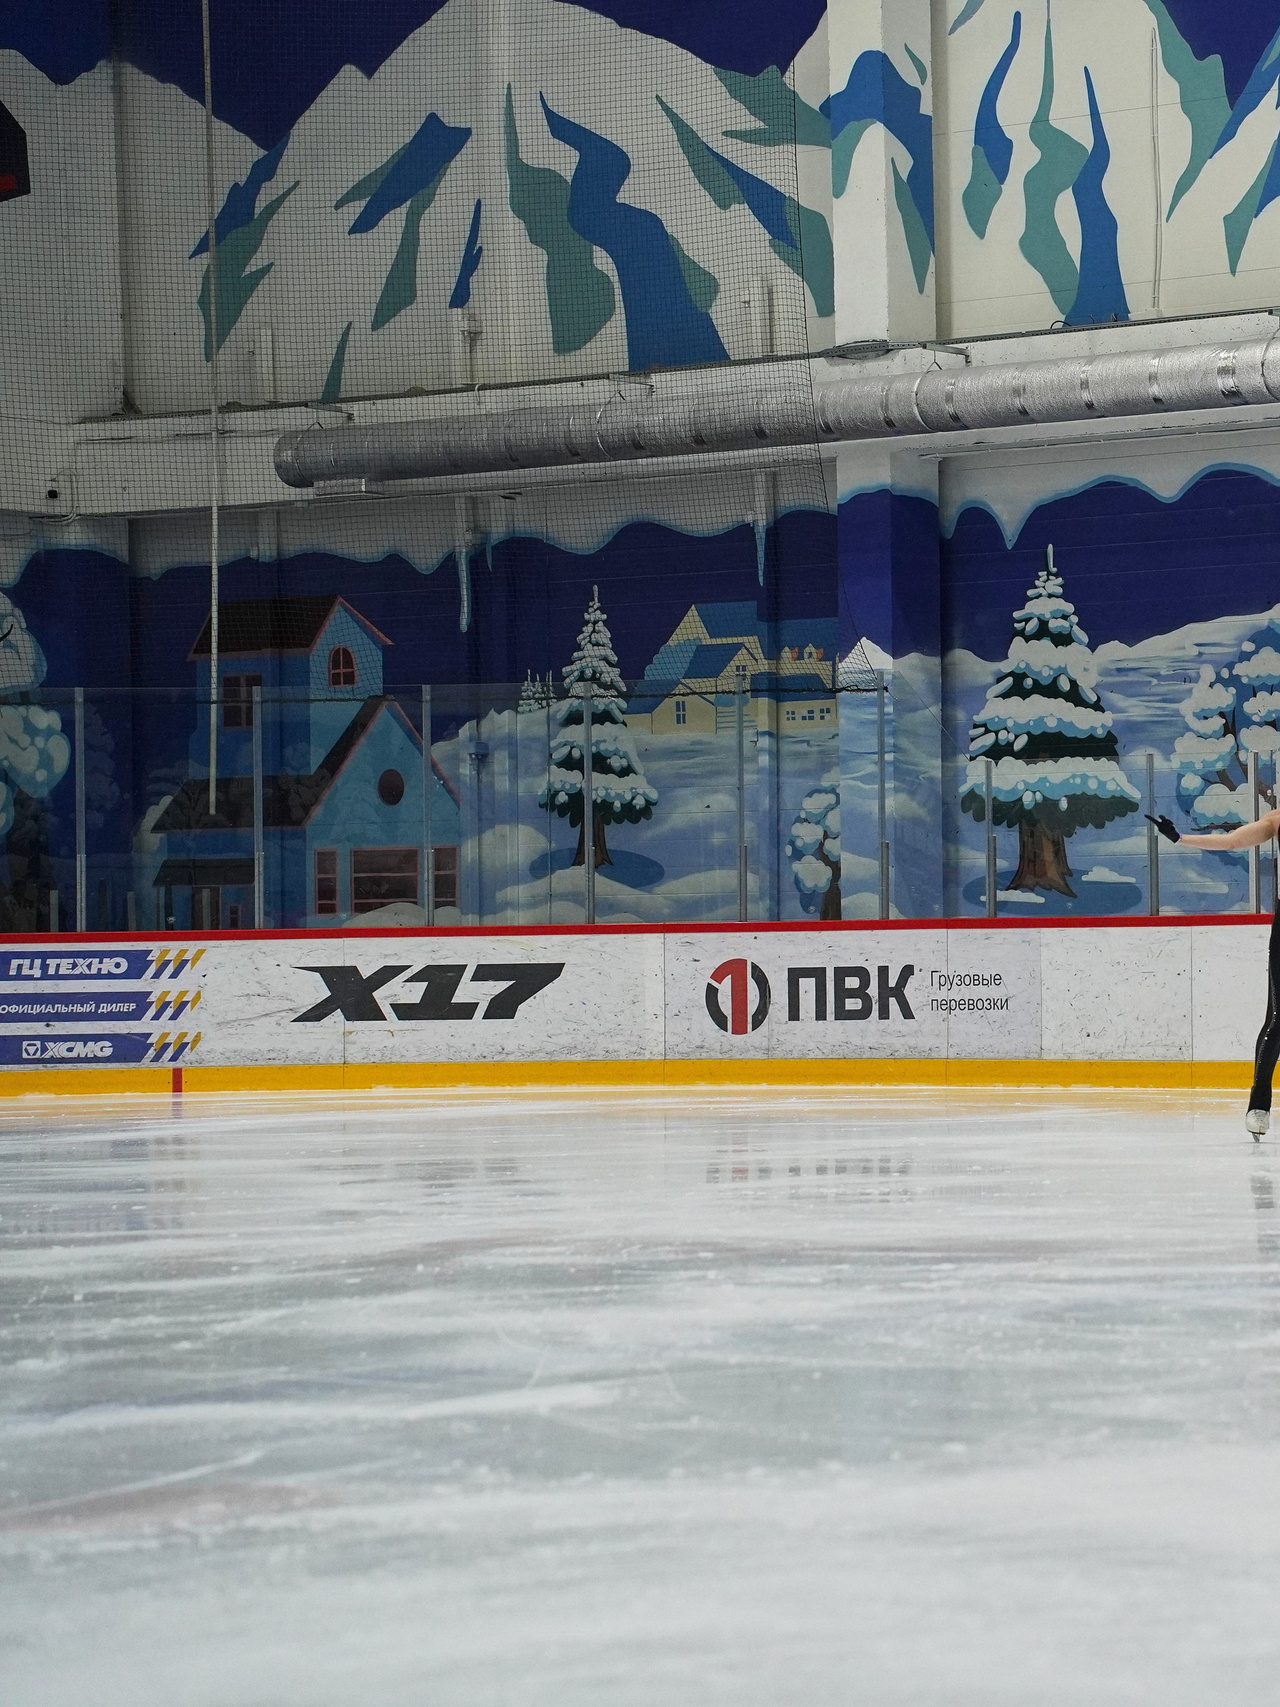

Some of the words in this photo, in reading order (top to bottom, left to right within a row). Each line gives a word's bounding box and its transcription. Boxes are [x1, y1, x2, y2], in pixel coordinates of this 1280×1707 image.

[8, 959, 42, 978] ГЦ
[46, 957, 129, 975] ТЕХНО
[930, 970, 1003, 992] Грузовые
[290, 962, 566, 1022] X17
[787, 964, 916, 1022] ПВК
[0, 1001, 96, 1015] ОФИЦИАЛЬНЫЙ
[98, 1002, 137, 1014] ДИЛЕР
[930, 997, 1010, 1016] перевозки
[41, 1040, 114, 1059] XCMG
